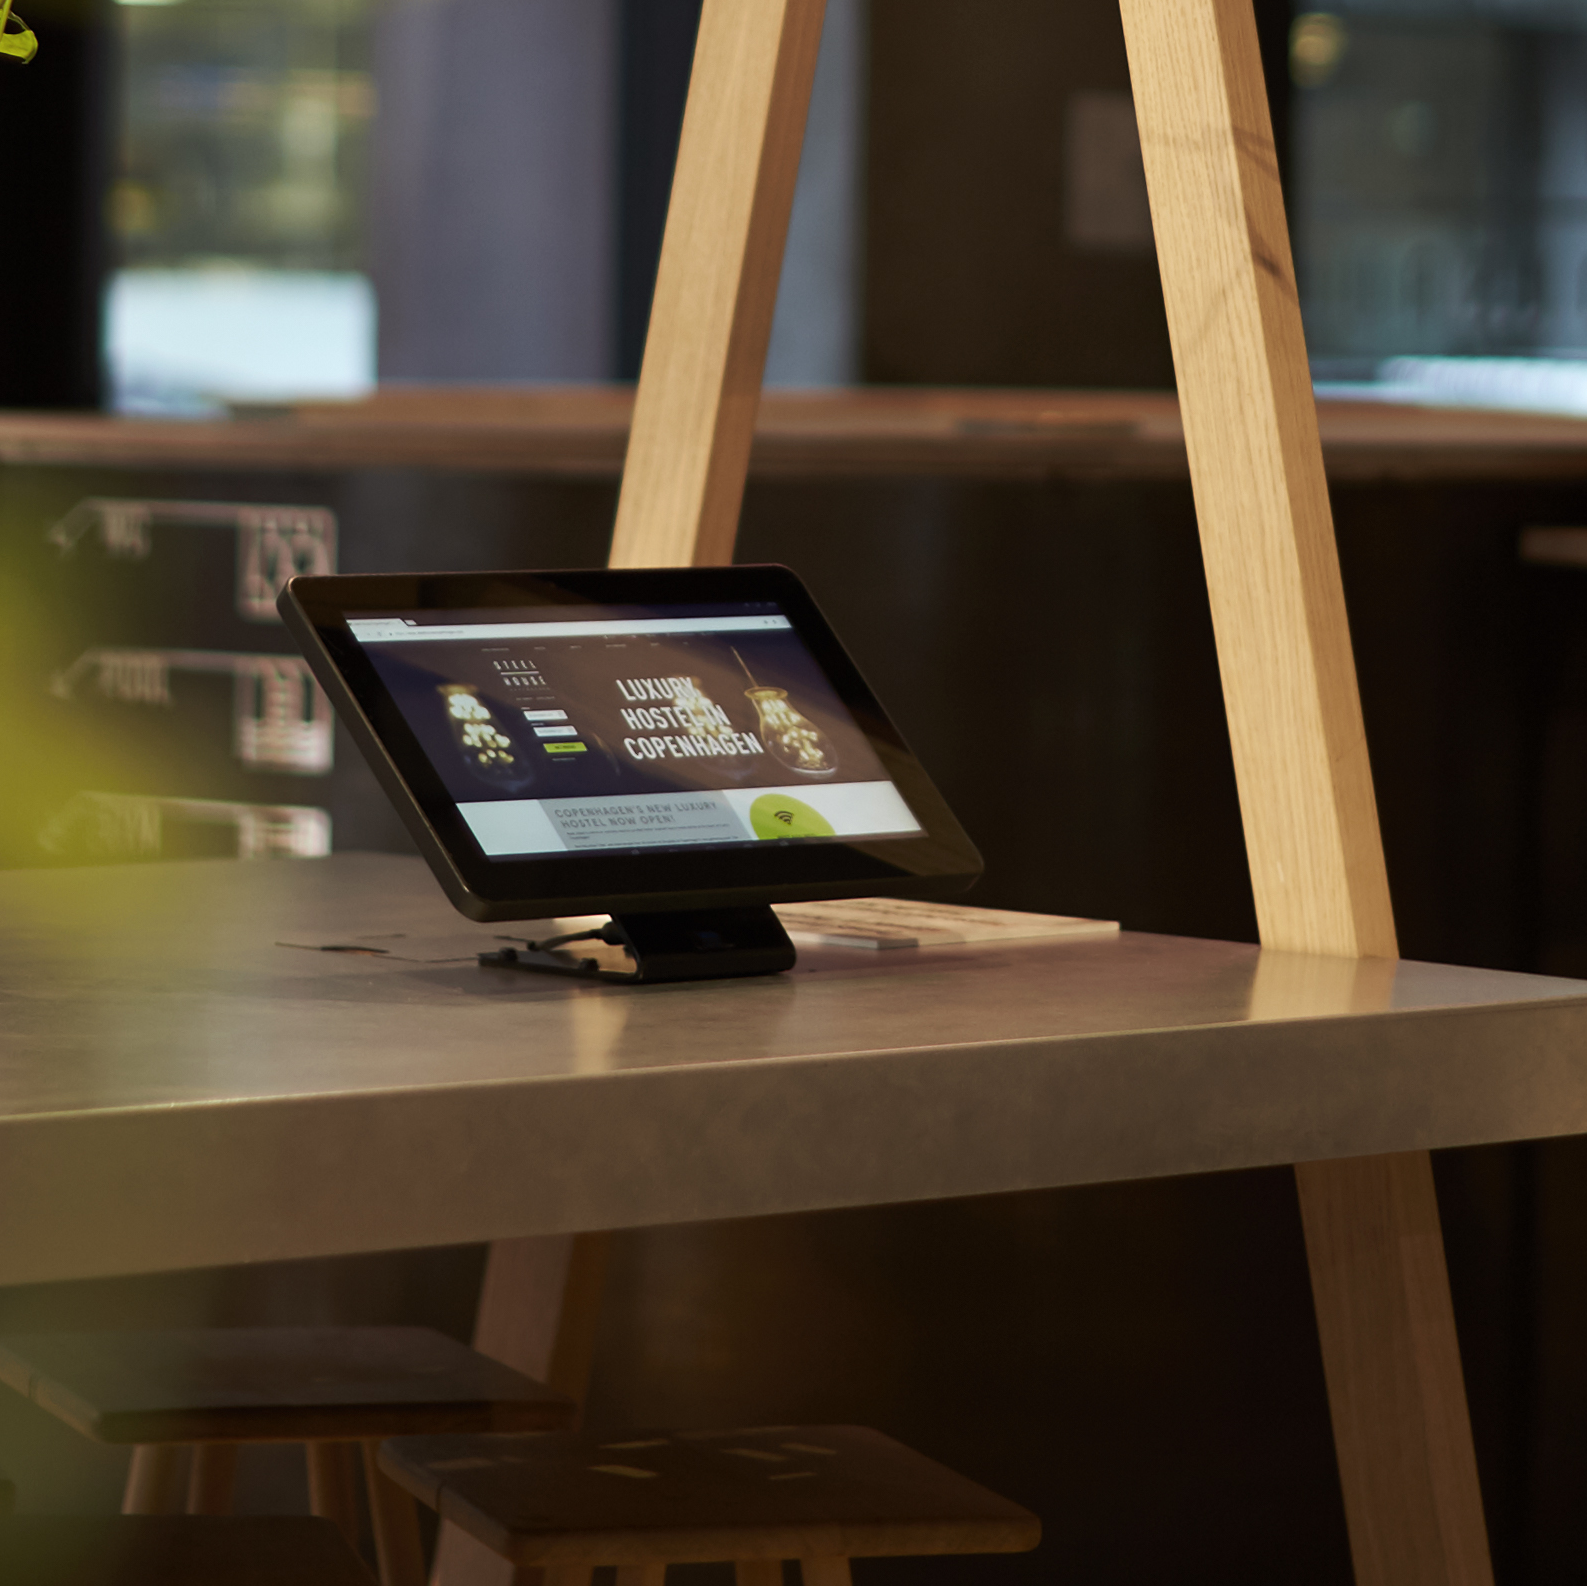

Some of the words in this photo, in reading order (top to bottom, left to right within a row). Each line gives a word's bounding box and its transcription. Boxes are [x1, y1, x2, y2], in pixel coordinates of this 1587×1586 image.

[492, 659, 537, 671] STEEL
[502, 674, 547, 687] HOUSE
[615, 676, 702, 701] LUXURY
[620, 705, 705, 730] HOSTEL
[703, 704, 732, 726] IN
[623, 731, 765, 760] COPENHAGEN
[554, 804, 645, 818] COPENHAGEN'S
[646, 803, 672, 814] NEW
[674, 801, 718, 814] LUXURY
[560, 815, 607, 829] HOSTEL
[609, 815, 637, 827] NOW
[640, 813, 676, 826] OPEN!
